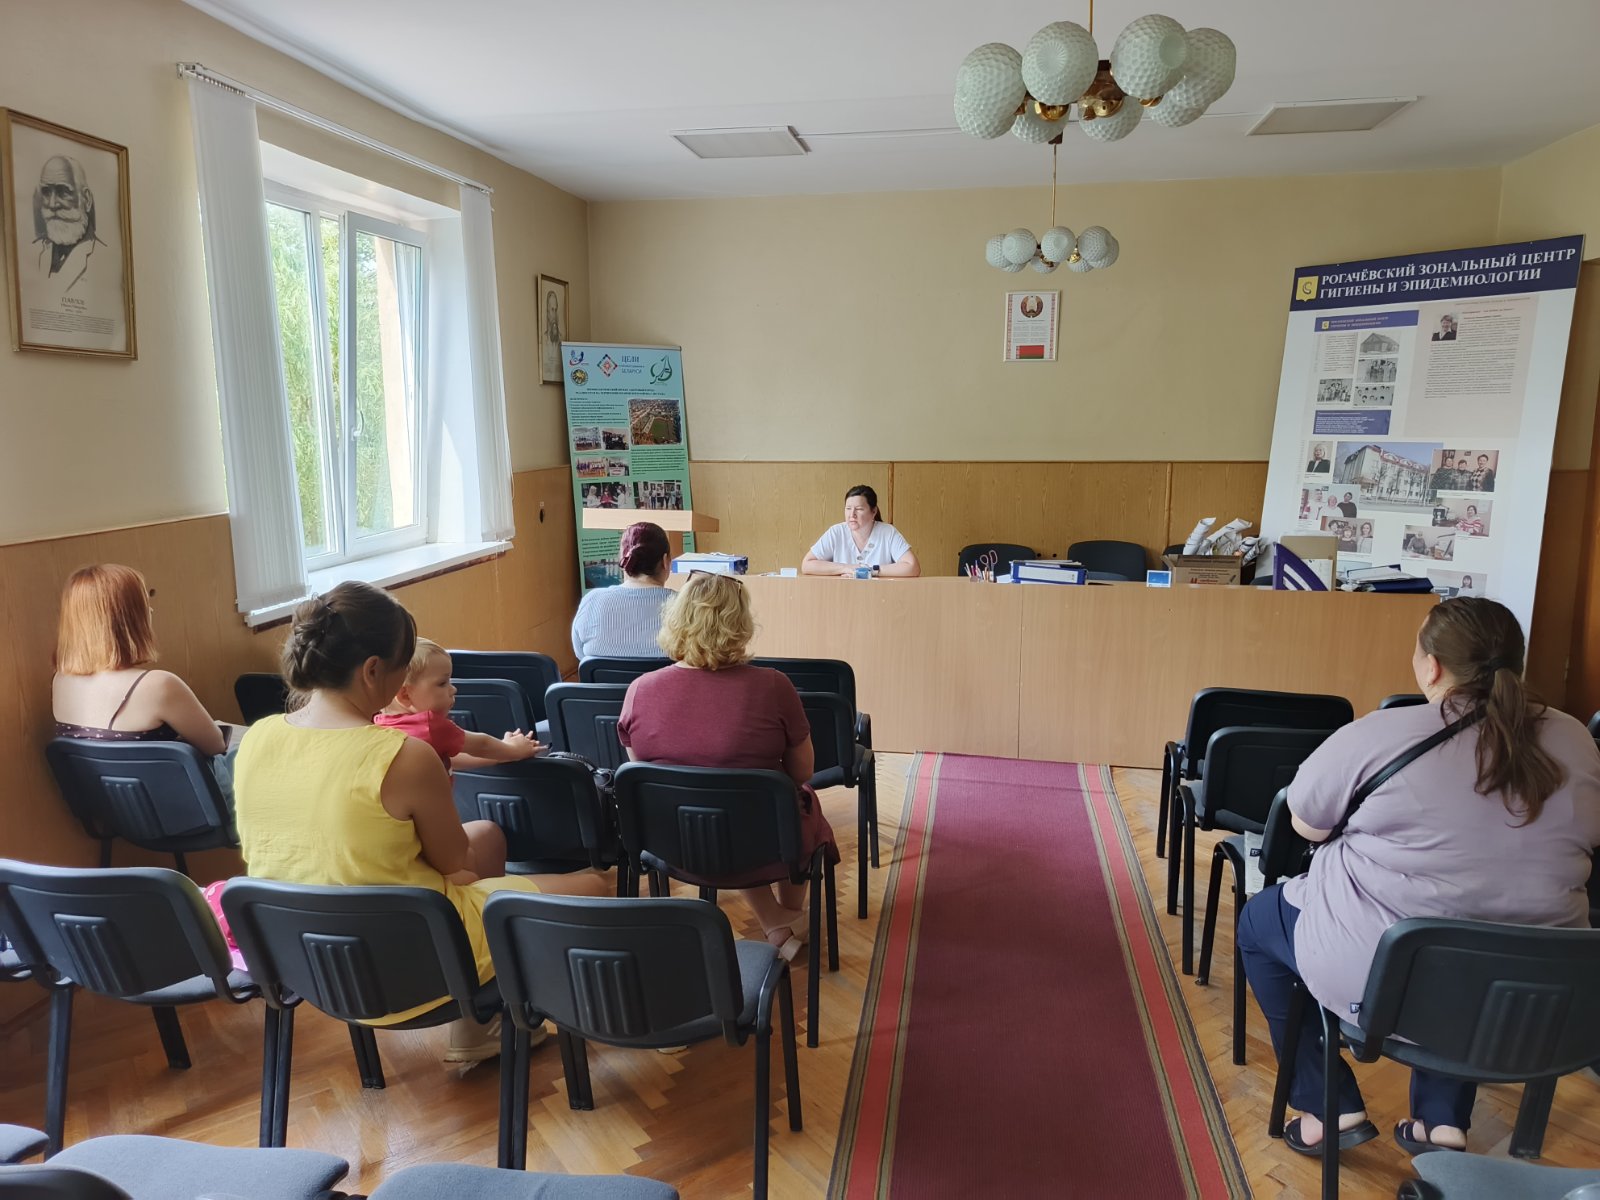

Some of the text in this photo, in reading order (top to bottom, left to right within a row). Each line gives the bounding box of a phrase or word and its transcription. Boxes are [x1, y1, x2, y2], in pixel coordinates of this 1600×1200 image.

[1320, 268, 1542, 299] ГИГИЕНЫ И ЭПИДЕМИОЛОГИИ
[1321, 248, 1576, 285] РОГАЧЁВСКИЙ ЗОНАЛЬНЫЙ ЦЕНТР
